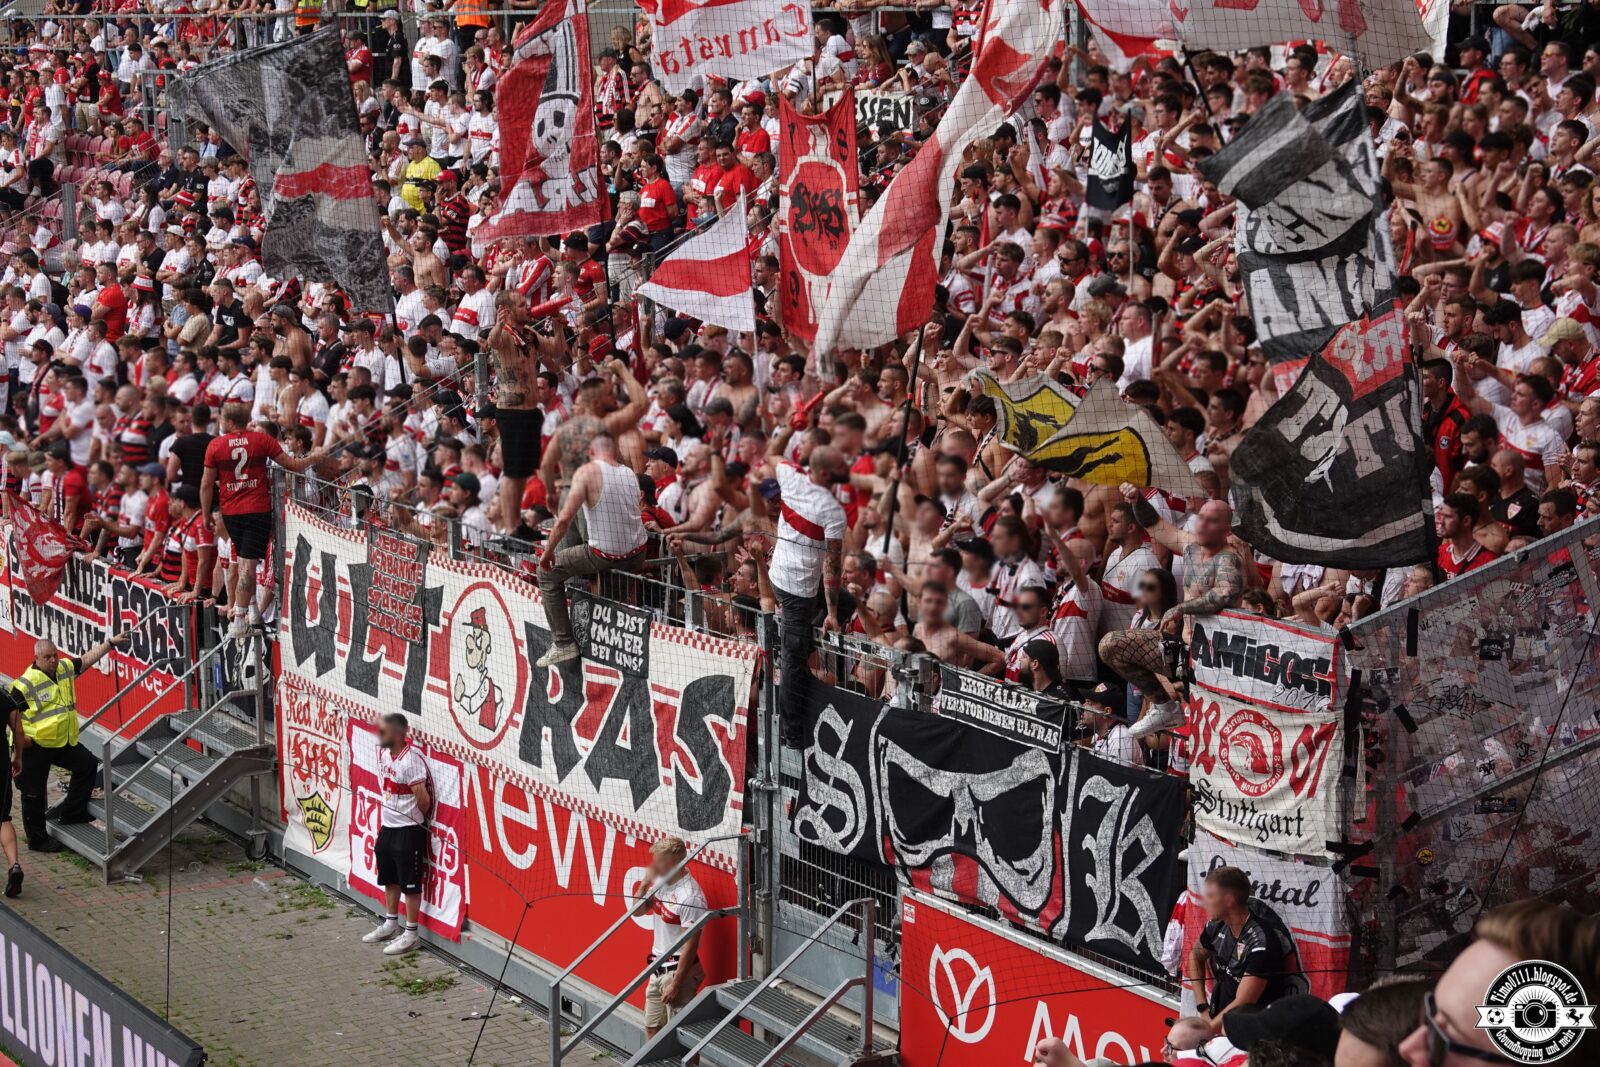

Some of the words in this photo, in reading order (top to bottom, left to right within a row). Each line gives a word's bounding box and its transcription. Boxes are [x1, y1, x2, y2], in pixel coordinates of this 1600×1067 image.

[828, 96, 912, 129] SSEN
[231, 447, 249, 481] 2
[226, 478, 258, 492] STUART
[375, 533, 418, 562] JEDER
[368, 544, 424, 586] VERBANNTE
[592, 603, 612, 624] DU
[616, 610, 647, 634] BIST
[590, 620, 644, 656] IMMER
[591, 641, 611, 661] BEI
[614, 649, 645, 672] UNS!
[958, 674, 996, 702] EHRE
[993, 686, 1041, 716] ALLEN
[940, 693, 1017, 732] VERSTORBENEN
[1015, 718, 1059, 747] ULTRAS
[1194, 777, 1305, 843] Stuttgart
